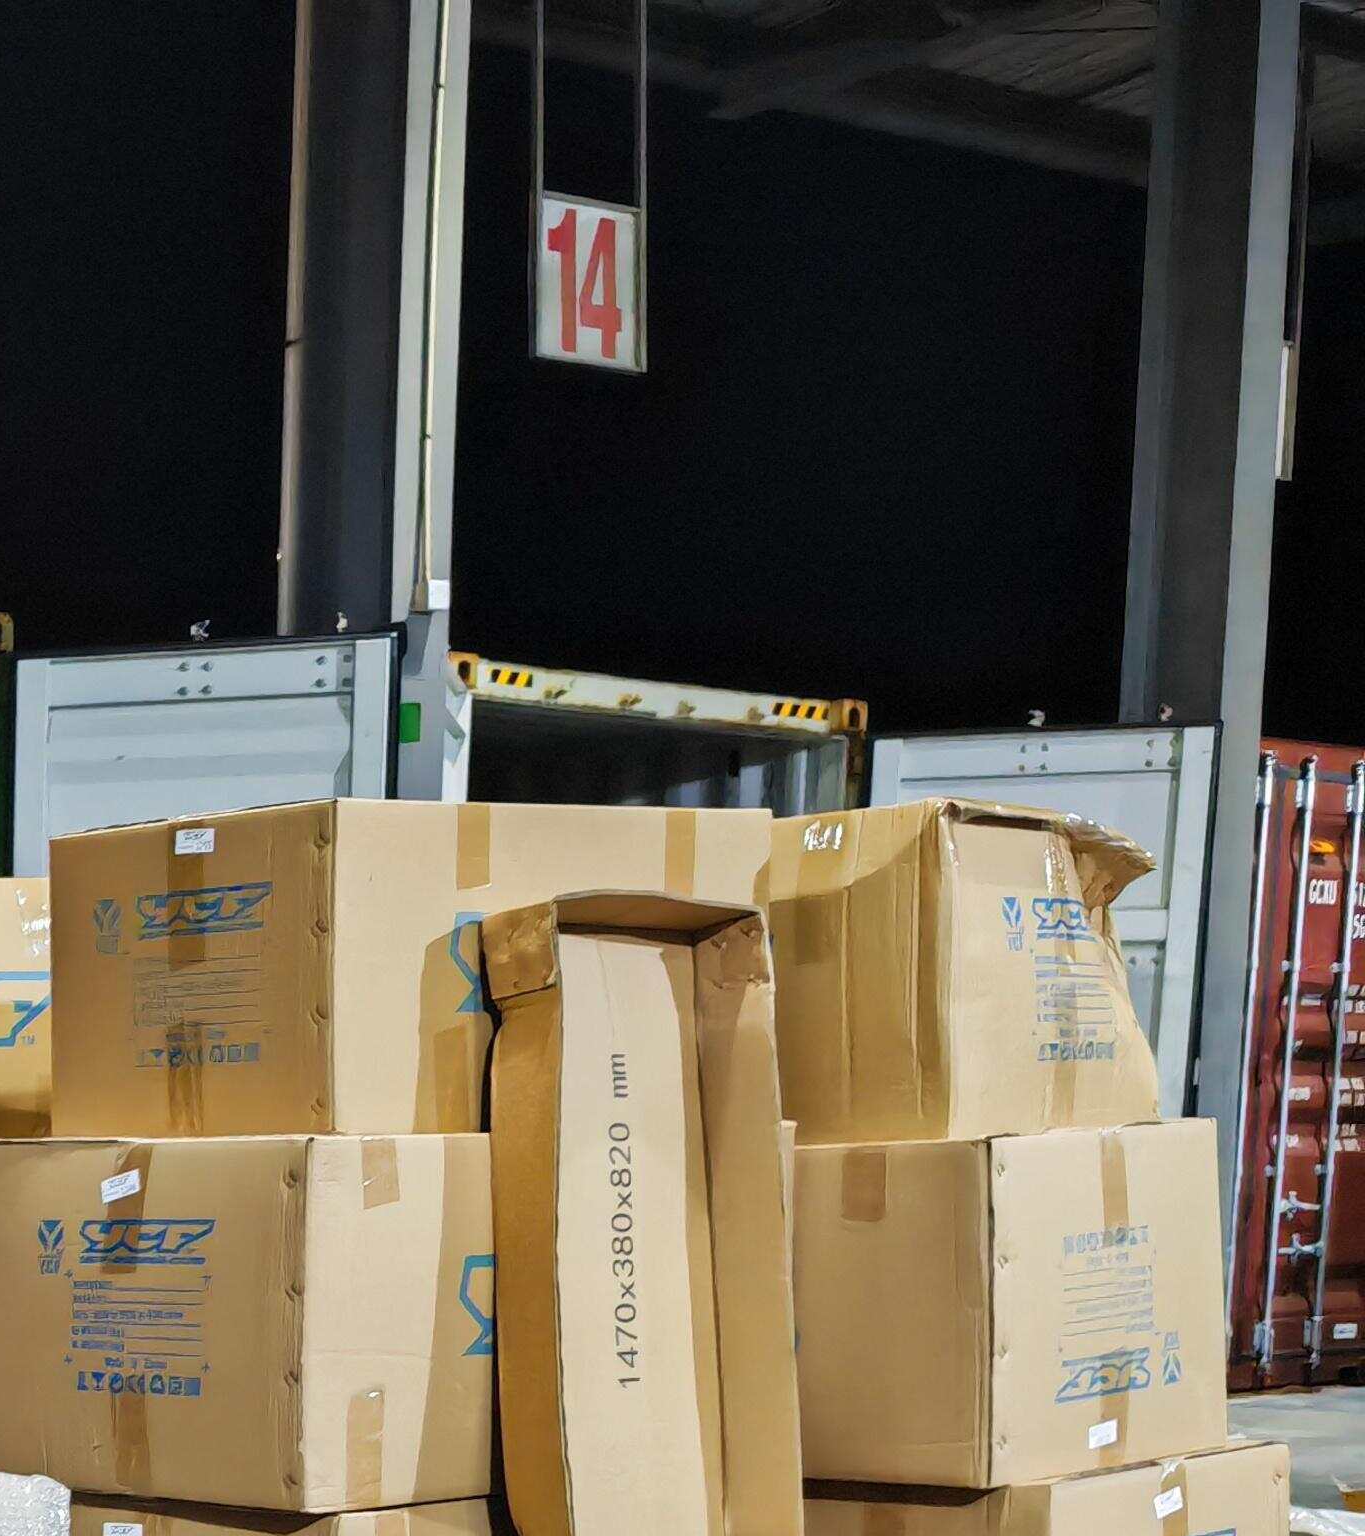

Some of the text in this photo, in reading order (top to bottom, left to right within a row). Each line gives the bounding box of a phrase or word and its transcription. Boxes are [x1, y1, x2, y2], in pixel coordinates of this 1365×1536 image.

[547, 207, 623, 360] 14
[135, 881, 273, 930] YCF
[1031, 897, 1089, 931] YC
[79, 1218, 216, 1254] YCF
[606, 1052, 642, 1390] 1470x380x820 mm
